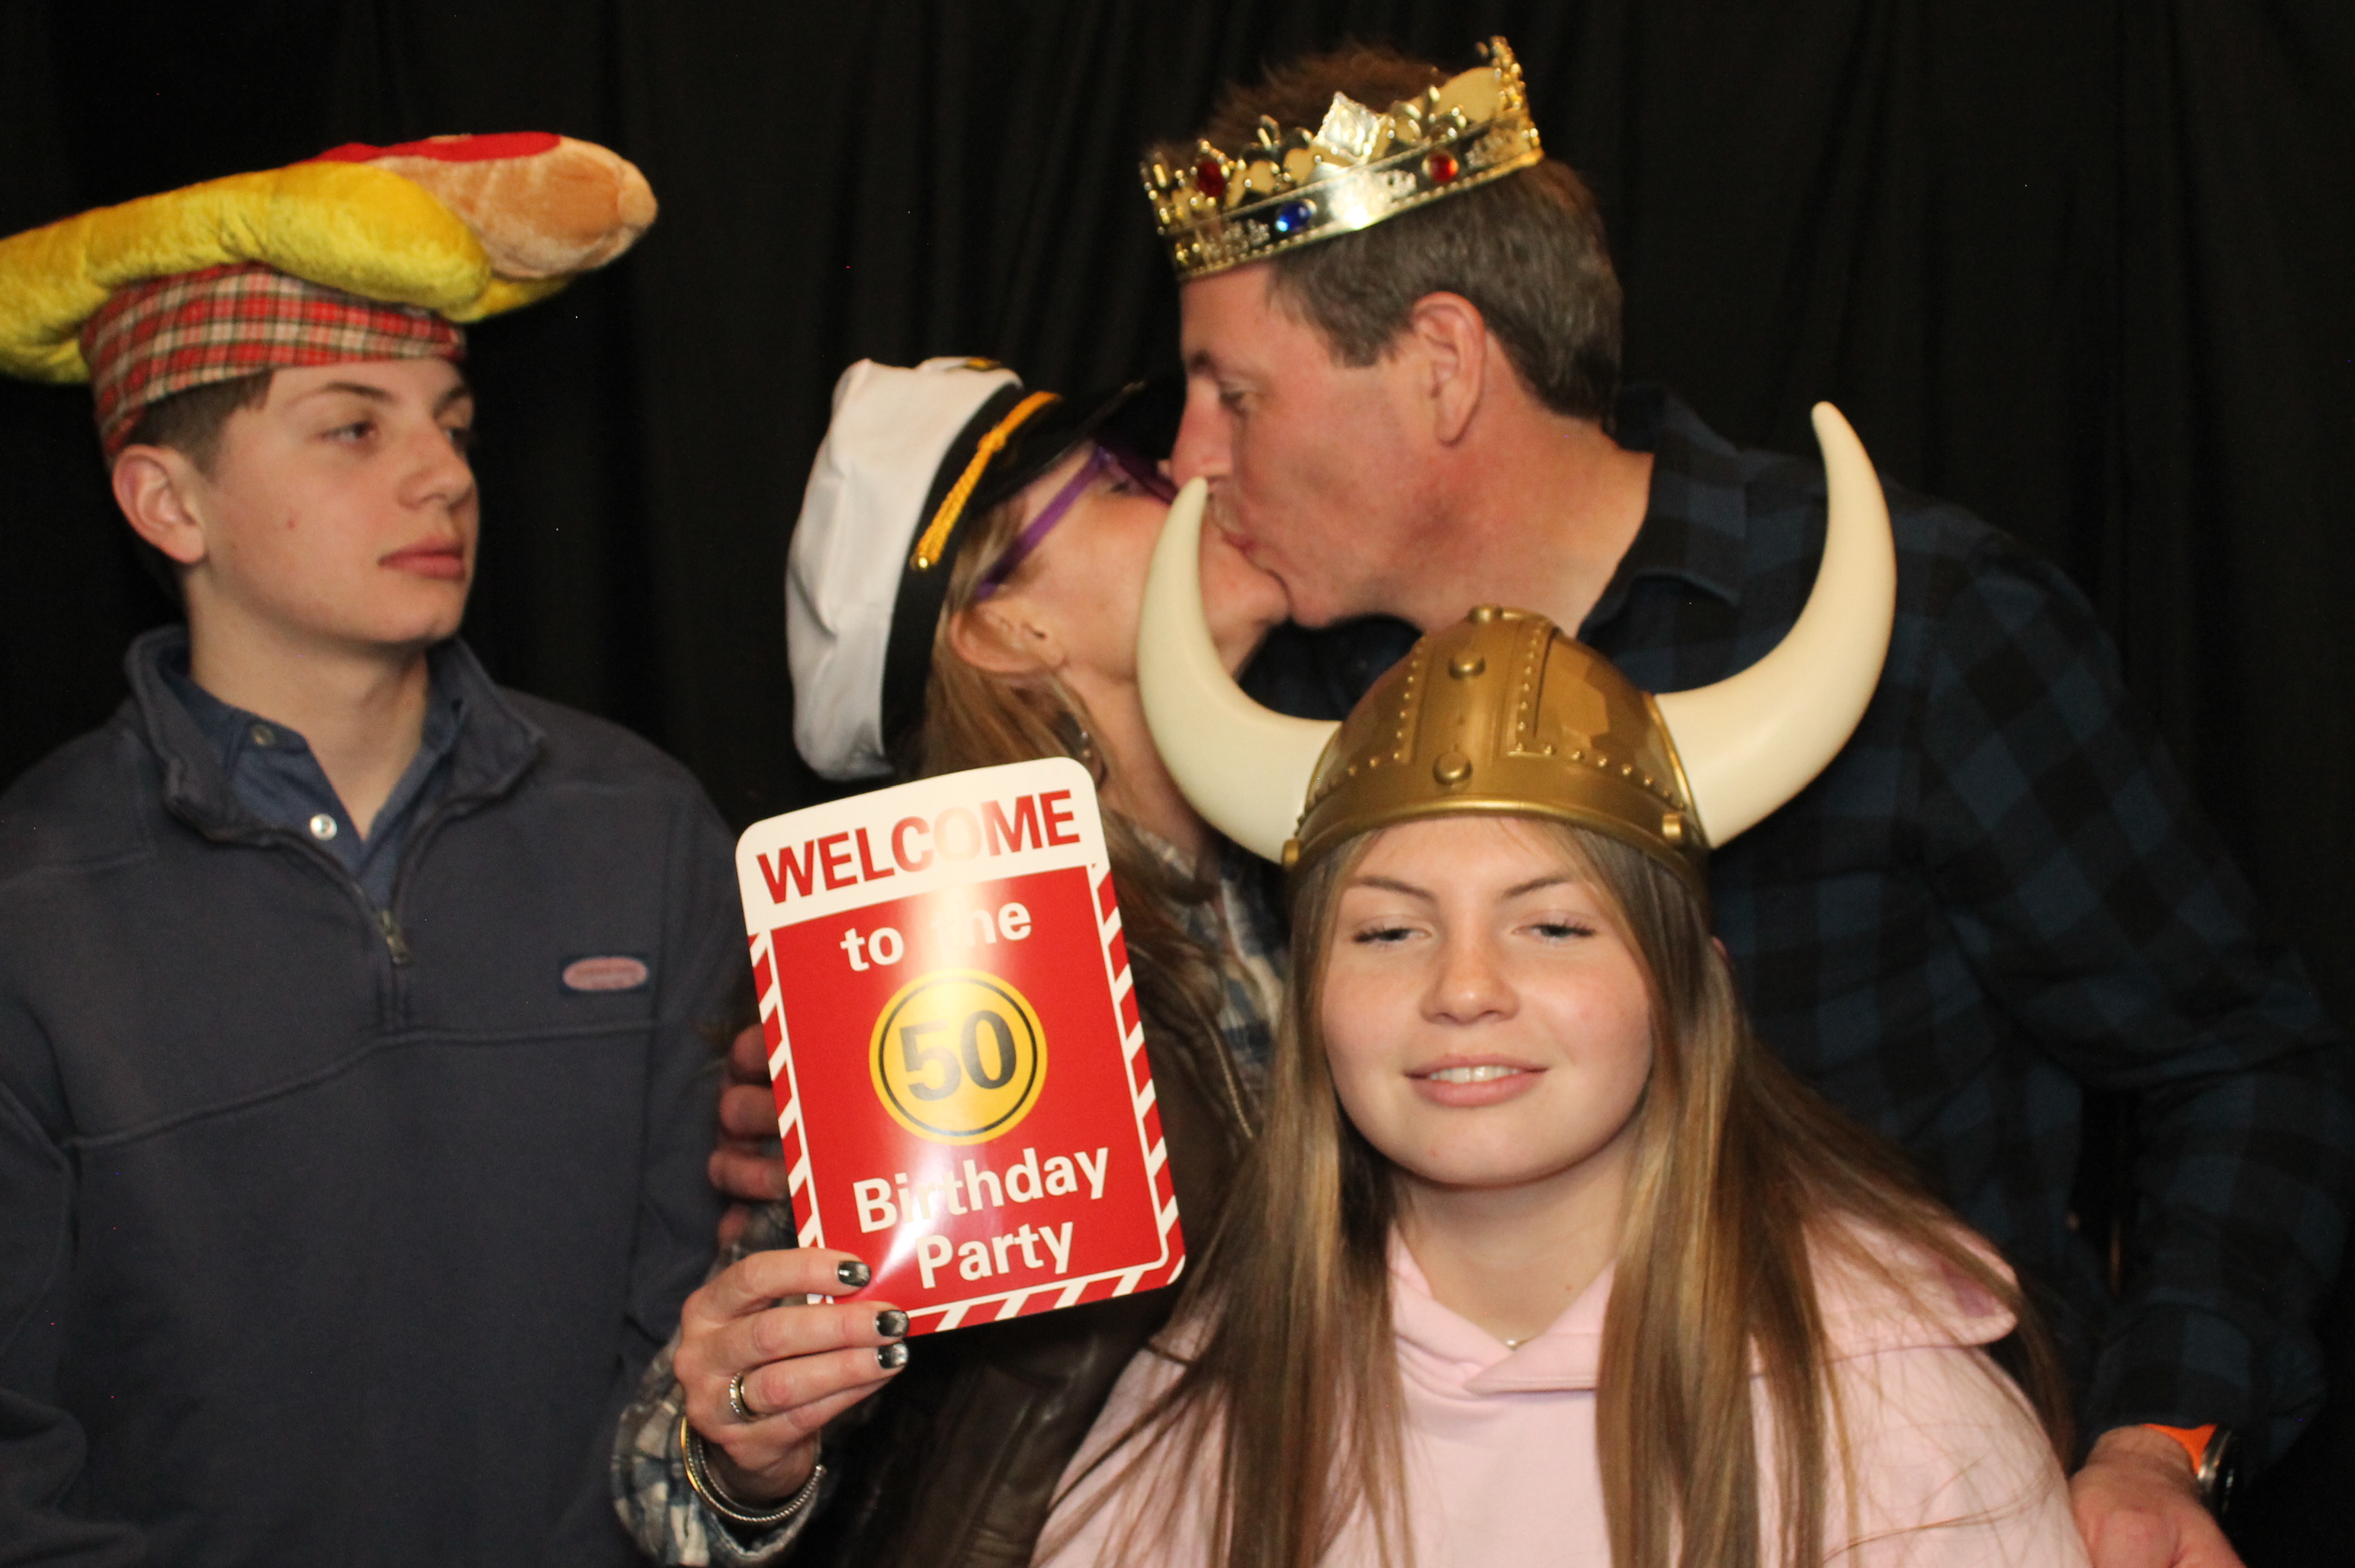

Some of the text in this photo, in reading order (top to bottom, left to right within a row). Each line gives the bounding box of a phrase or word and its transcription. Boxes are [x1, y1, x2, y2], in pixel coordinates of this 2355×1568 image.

[757, 789, 1081, 904] WELCOME
[840, 927, 904, 972] to
[899, 1010, 1017, 1101] 50
[853, 1147, 1109, 1233] Birthday
[915, 1221, 1074, 1289] Party
